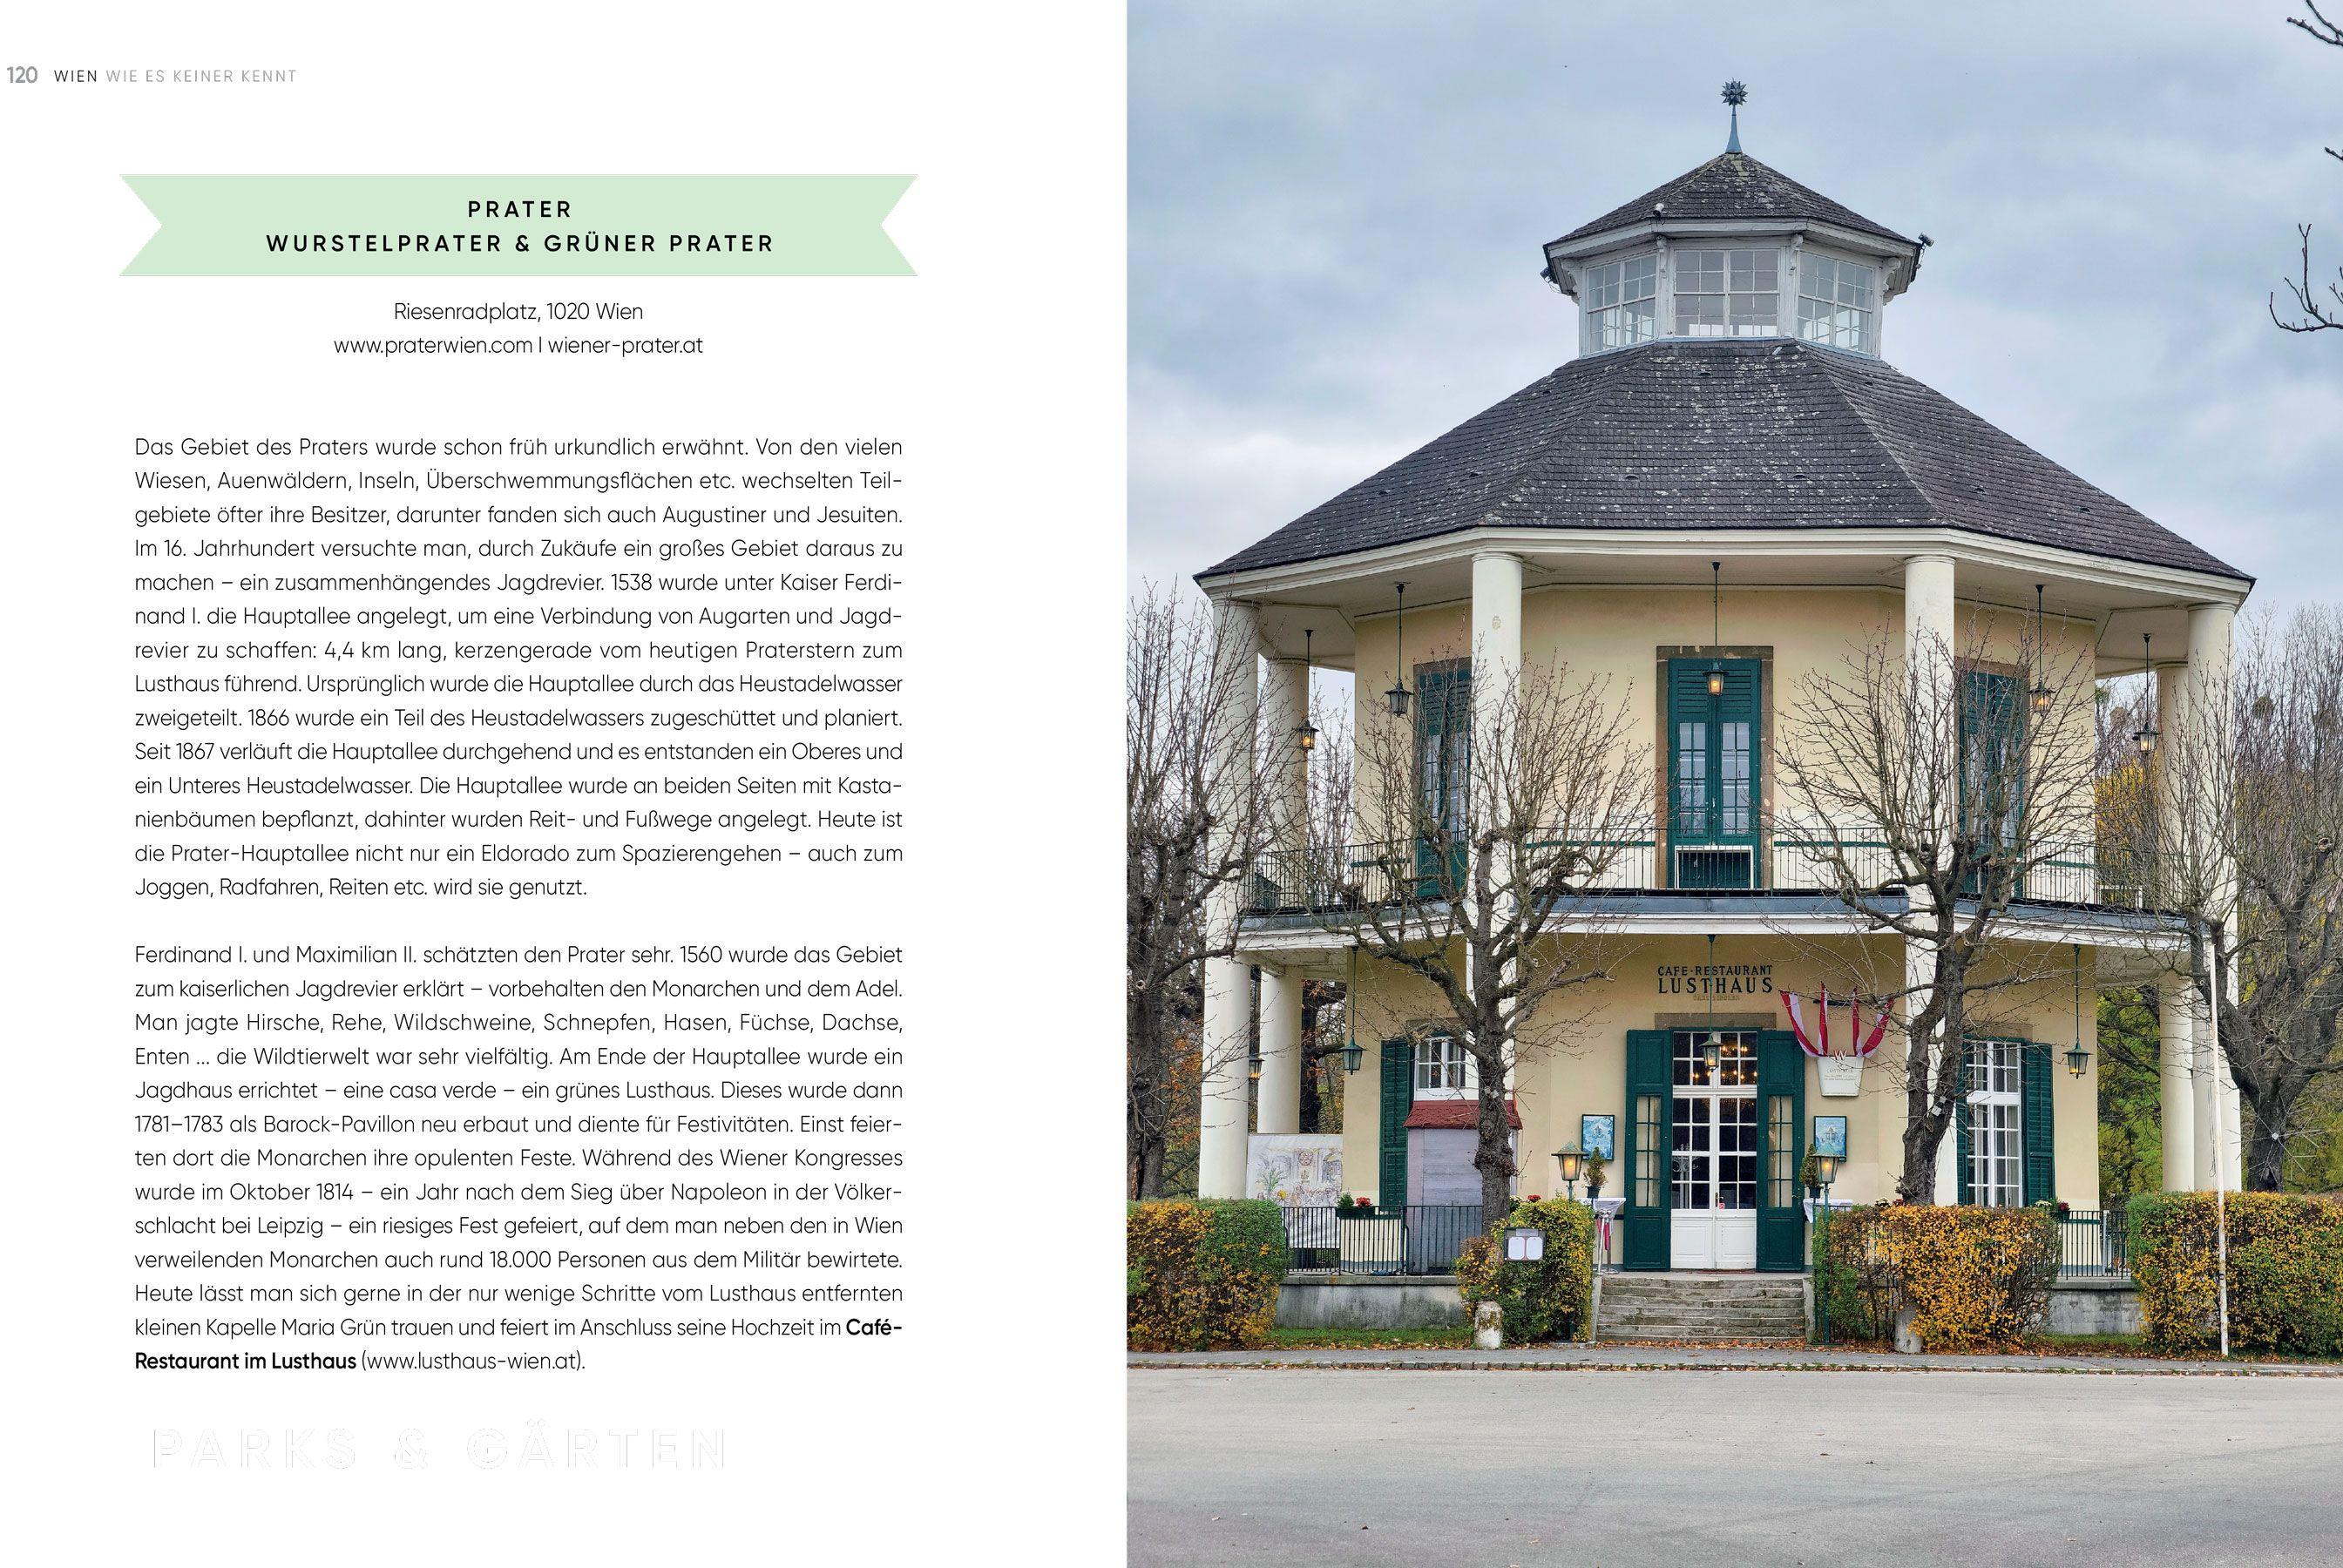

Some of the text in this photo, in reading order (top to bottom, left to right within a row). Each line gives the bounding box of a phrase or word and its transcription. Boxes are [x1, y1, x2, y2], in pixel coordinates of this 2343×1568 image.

[6, 65, 295, 84] 120 WIEN WIE ES KEINER KENNT
[468, 199, 571, 219] PRATER
[265, 230, 772, 253] WURSTELPRATER & GRÜNER PRATER
[395, 301, 643, 325] Riesenradplatz, 1020 Wien
[334, 335, 533, 358] www.praterwien.com
[547, 335, 704, 358] wiener-prater.at
[135, 436, 902, 456] Das Gebiet des Praters wurde schon früh urkundlich erwähnt. Von den vielen
[134, 468, 902, 494] Wiesen, Auenwäldern, Inseln, Überschwemmungsflächen etc. wechselten Teil-
[134, 504, 903, 528] gebiete öfter ihre Besitzer, darunter fanden sich auch Augustiner und Jesuiten.
[135, 640, 903, 664] revier zu schaffen: 4,4 km lang, kerzengerade vom heutigen Praterstern zum
[135, 673, 904, 697] Lusthaus führend. Ursprünglich wurde die Hauptallee durch das Heustadelwasser
[135, 707, 903, 731] zweigeteilt. 1866 wurde ein Teil des Heustadelwassers zugeschüttet und planiert.
[135, 808, 903, 833] nienbäumen bepflanzt, dahinter wurden Reit- und Fußwege angelegt. Heute ist
[135, 877, 587, 900] Joggen, Radfahren, Reiten etc. wird sie genutzt.
[1658, 977, 1773, 994] LUSTHAUS
[135, 1012, 903, 1036] Man jagte Hirsche, Rehe, Wildschweine, Schnepfen, Hasen, Füchse, Dachse,
[134, 1147, 904, 1171] ten dort die Monarchen ihre opulenten Feste. Während des Wiener Kongresses
[134, 1249, 903, 1268] verweilenden Monarchen auch rund 18.000 Personen aus dem Militär bewirtete.
[135, 1317, 903, 1341] kleinen Kapelle Maria Grün trauen und feiert im Anschluss seine Hochzeit im Café-
[135, 1349, 586, 1372] Restaurant im Lusthaus (www.lusthaus-wien.at).
[153, 1417, 724, 1470] PARKS & GÄRTEN
